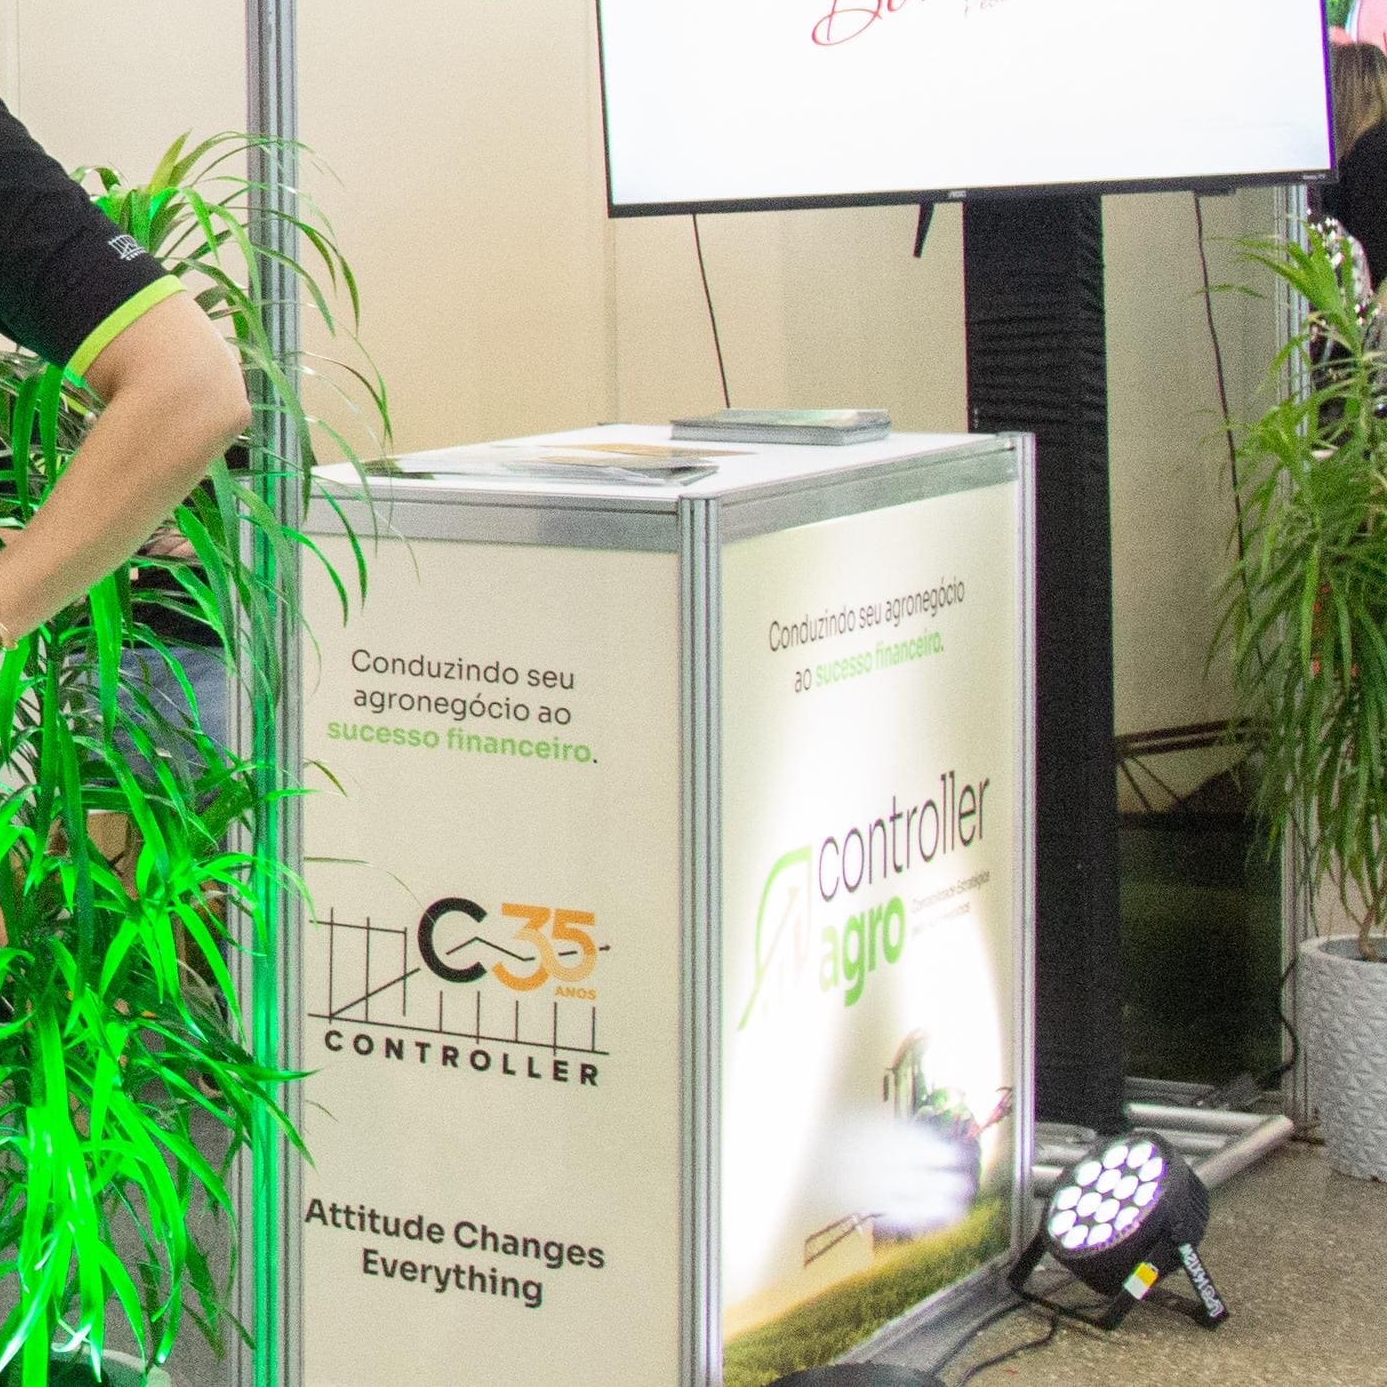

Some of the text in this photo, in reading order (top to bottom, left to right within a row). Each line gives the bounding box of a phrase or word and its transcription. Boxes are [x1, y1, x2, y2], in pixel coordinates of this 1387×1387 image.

[769, 576, 966, 653] Conduzindo seu agronegócio
[351, 649, 575, 690] Conduzindo seu
[794, 628, 945, 694] ao sucesso financeiro.
[353, 689, 572, 726] agronegócio ao
[327, 720, 599, 764] sucesso financeiro.
[819, 770, 990, 903] controller
[819, 895, 907, 1007] agro
[555, 985, 597, 1000] ANOS
[324, 1029, 600, 1087] CONTROLLER
[305, 1198, 606, 1270] Attitude Changes
[362, 1248, 544, 1309] Everything
